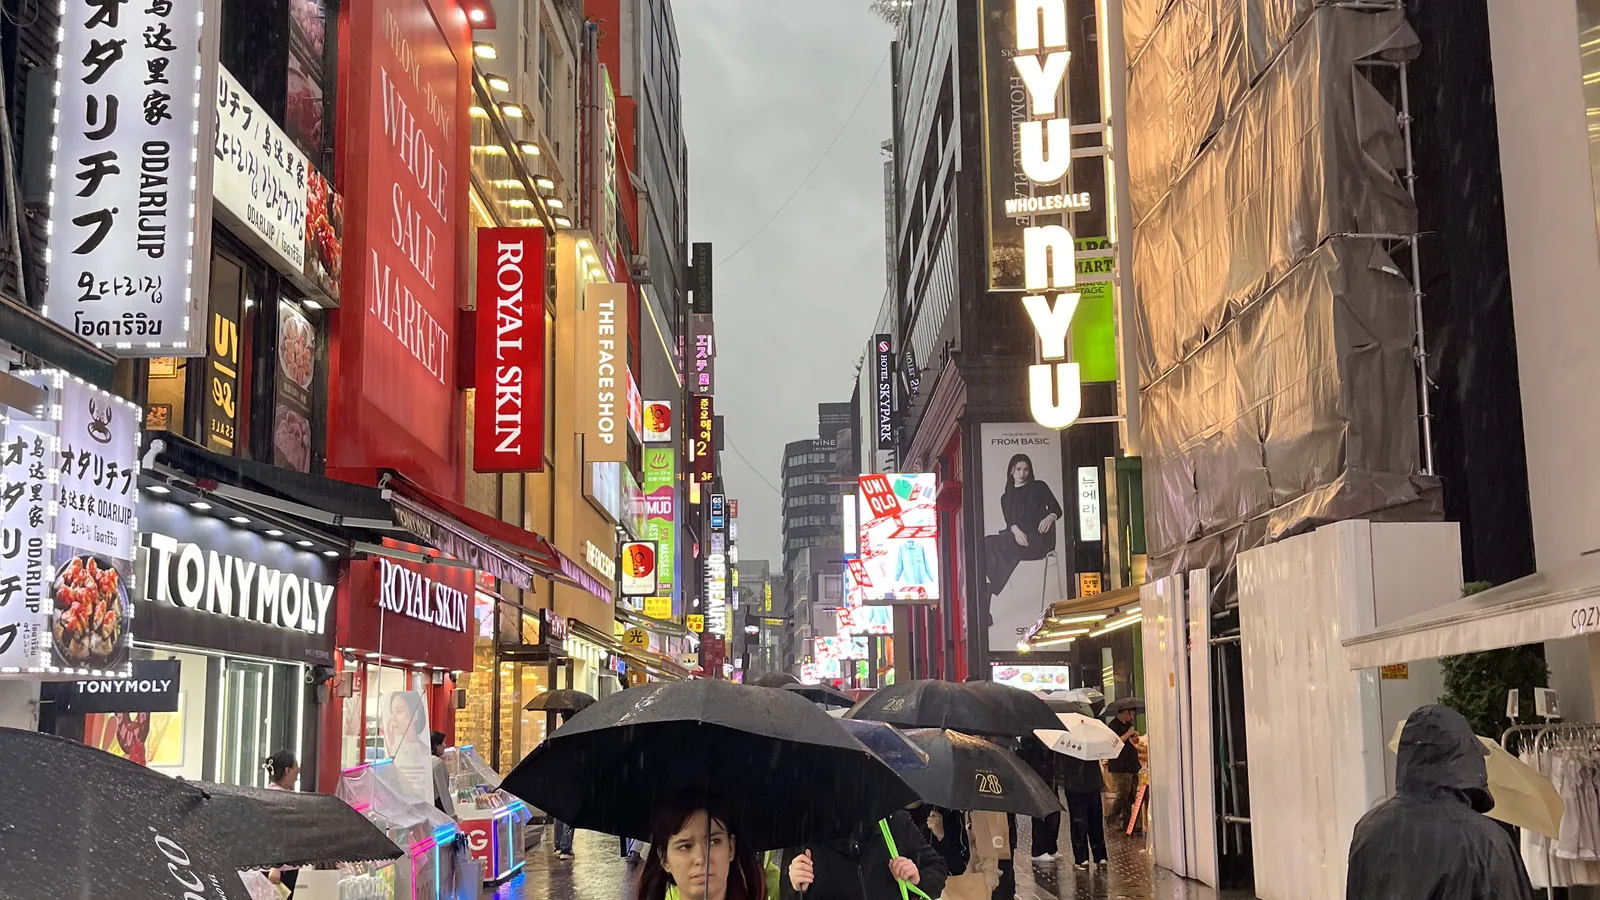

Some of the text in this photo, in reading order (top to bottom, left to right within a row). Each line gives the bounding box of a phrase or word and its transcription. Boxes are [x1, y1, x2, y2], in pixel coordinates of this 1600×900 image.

[380, 65, 449, 223] WHOLE
[137, 141, 170, 258] ODARIJIP
[1005, 192, 1090, 213] WHOLESALE
[1013, 171, 1030, 226] PLAE
[247, 203, 275, 241] ODARIJIP
[391, 182, 436, 290] SALE
[77, 271, 163, 303] 오다리집
[1078, 286, 1105, 295] TAGE
[370, 247, 449, 385] MARKET
[598, 300, 614, 335] THE
[495, 240, 523, 456] ROYAL SKIN
[598, 340, 614, 395] FACE
[598, 398, 614, 445] SHOP
[879, 383, 892, 442] SKYPARK
[696, 440, 707, 456] 2
[991, 437, 1050, 446] FROM BASIC
[701, 471, 712, 481] 3F
[862, 478, 888, 495] UNI
[97, 498, 131, 525] ODARIJIP
[647, 501, 671, 514] MUD
[870, 494, 897, 513] QLO
[25, 537, 43, 613] ODARIJIP
[660, 543, 669, 576] MASSAGE
[150, 532, 335, 634] TONYMOLY
[379, 557, 468, 633] ROYAL SKIN
[629, 630, 642, 643] 光
[77, 680, 171, 693] TONYMOLY
[975, 773, 1002, 794] 28
